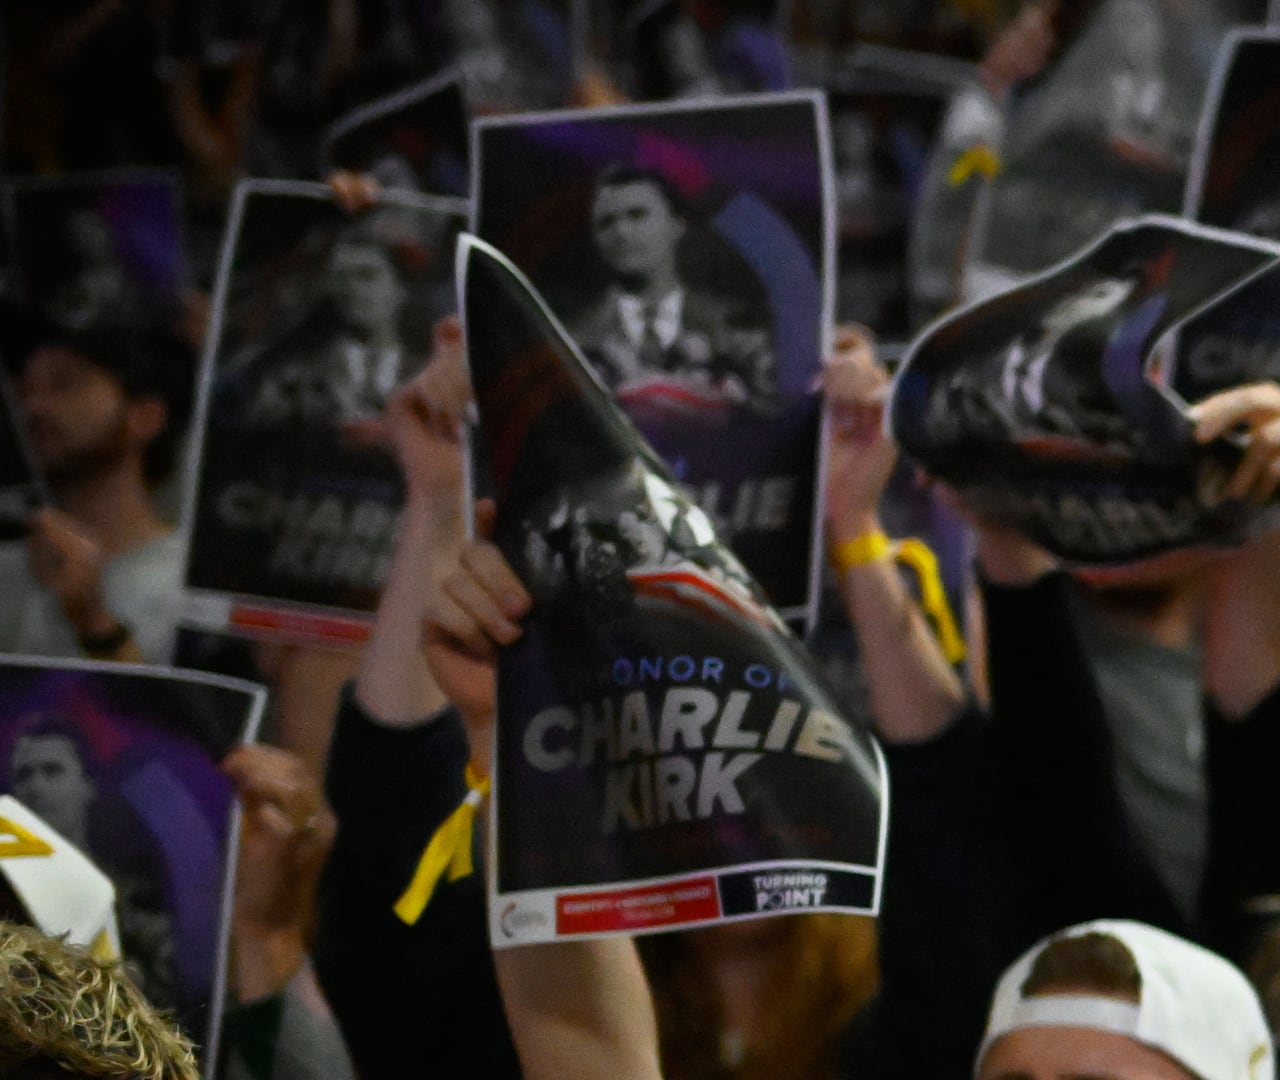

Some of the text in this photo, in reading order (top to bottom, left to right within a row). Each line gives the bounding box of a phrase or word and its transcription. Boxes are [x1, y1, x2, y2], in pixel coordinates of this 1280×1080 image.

[612, 655, 725, 685] ONOR
[522, 687, 852, 772] CHARLIE
[602, 752, 762, 836] KIRK
